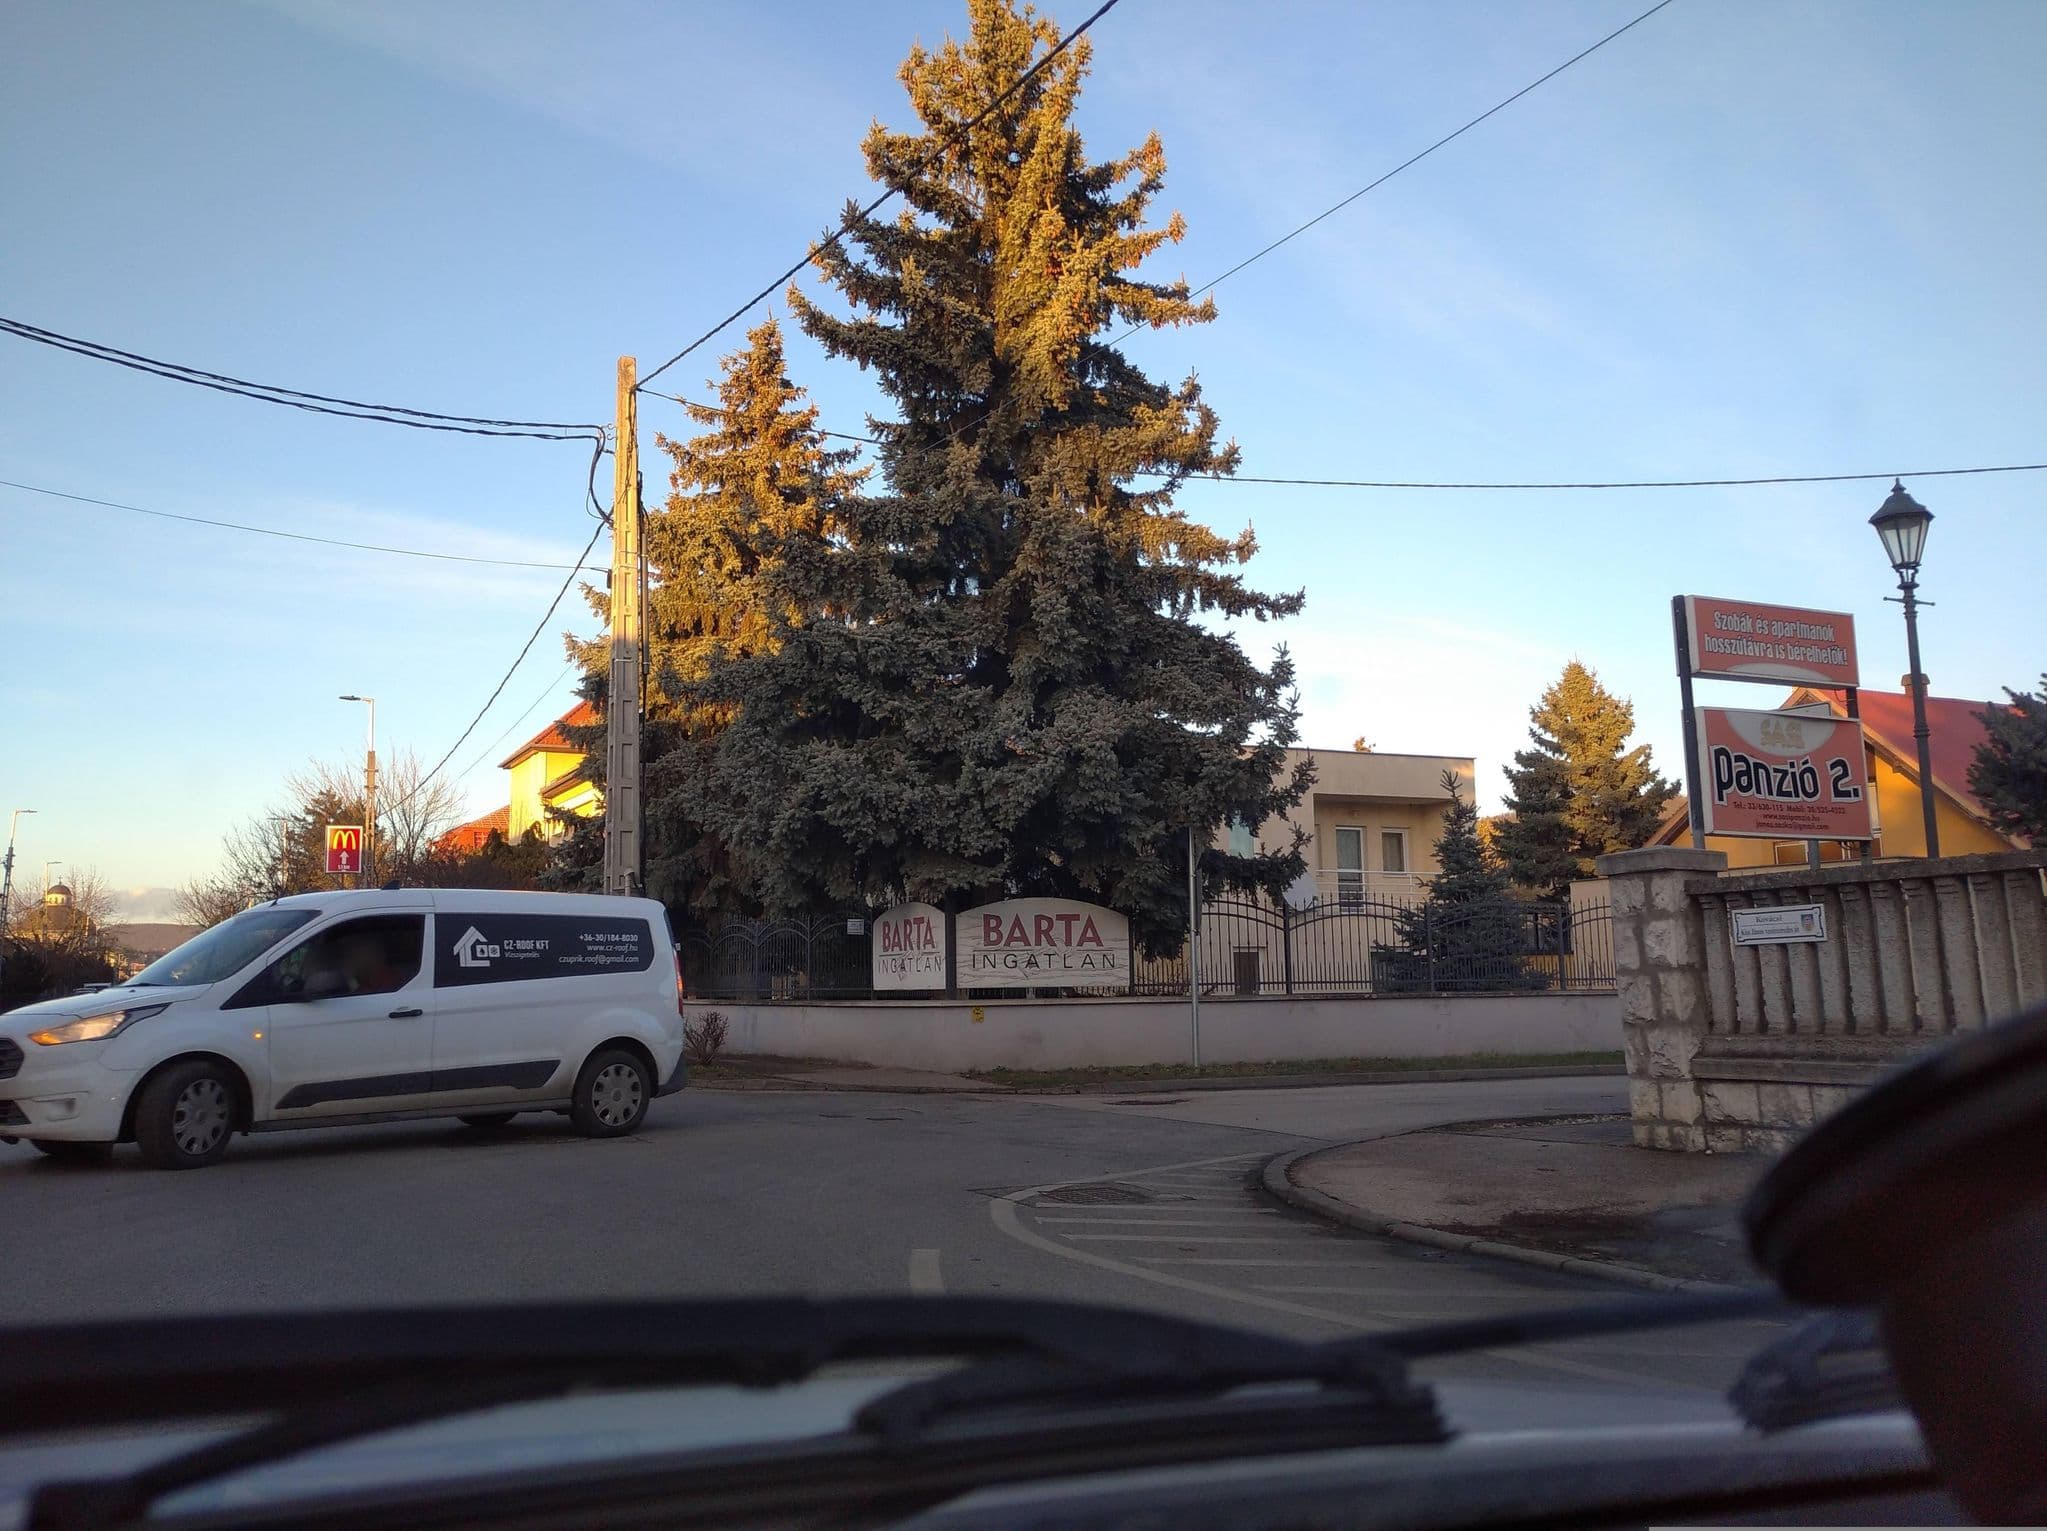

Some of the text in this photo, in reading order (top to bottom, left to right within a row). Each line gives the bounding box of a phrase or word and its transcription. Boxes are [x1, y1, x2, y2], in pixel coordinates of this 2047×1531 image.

[1714, 610, 1835, 642] Szobák és apartmanok
[1704, 633, 1848, 666] hosszútávra is bérelhetők!
[1829, 757, 1861, 799] 2.
[535, 939, 549, 950] KFT
[882, 916, 936, 953] BARTA
[983, 913, 1104, 948] BARTA
[586, 943, 638, 953] www.cz-roof.hu
[878, 954, 944, 974] INGATLAN
[972, 953, 1116, 970] INGATLAN
